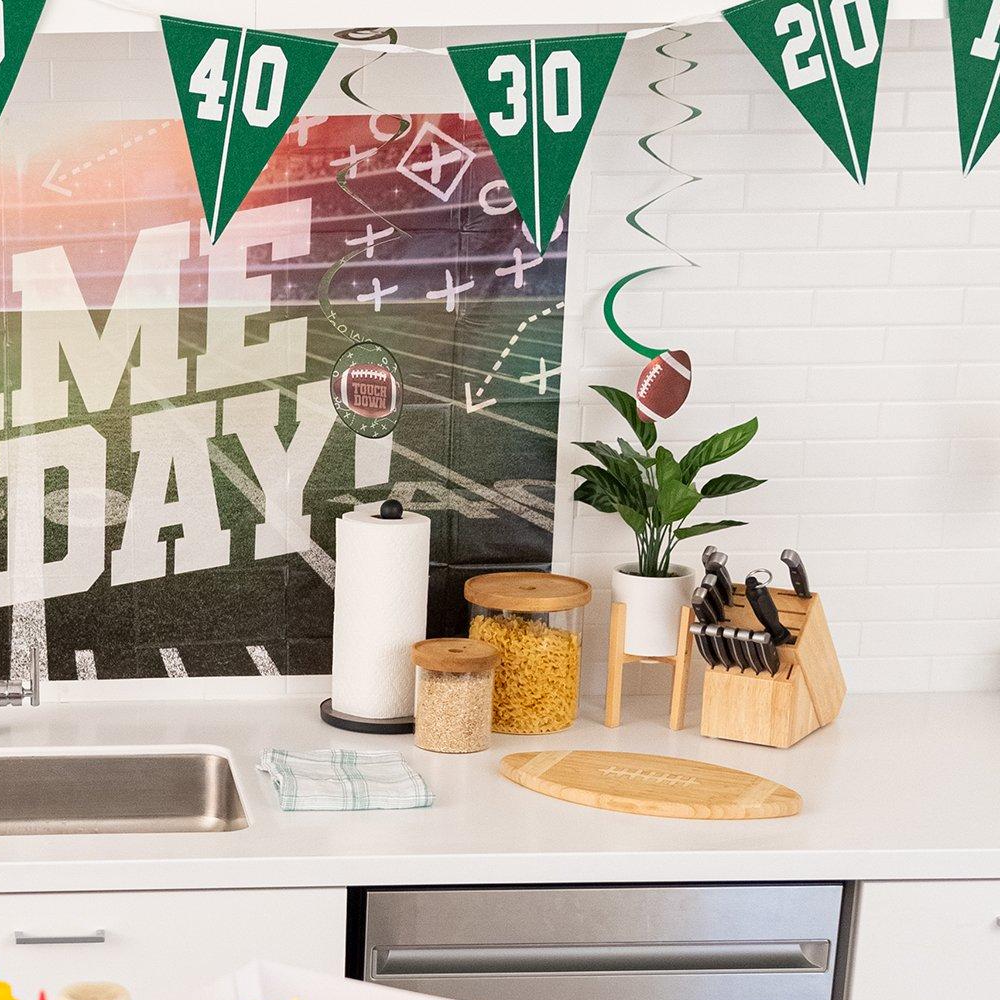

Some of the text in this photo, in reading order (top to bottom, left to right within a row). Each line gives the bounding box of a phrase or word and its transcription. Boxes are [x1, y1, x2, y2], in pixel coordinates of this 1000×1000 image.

[188, 38, 289, 128] 40
[773, 0, 879, 90] 20
[487, 50, 582, 137] 30
[352, 382, 387, 397] TOUCH
[354, 395, 386, 409] DOWN
